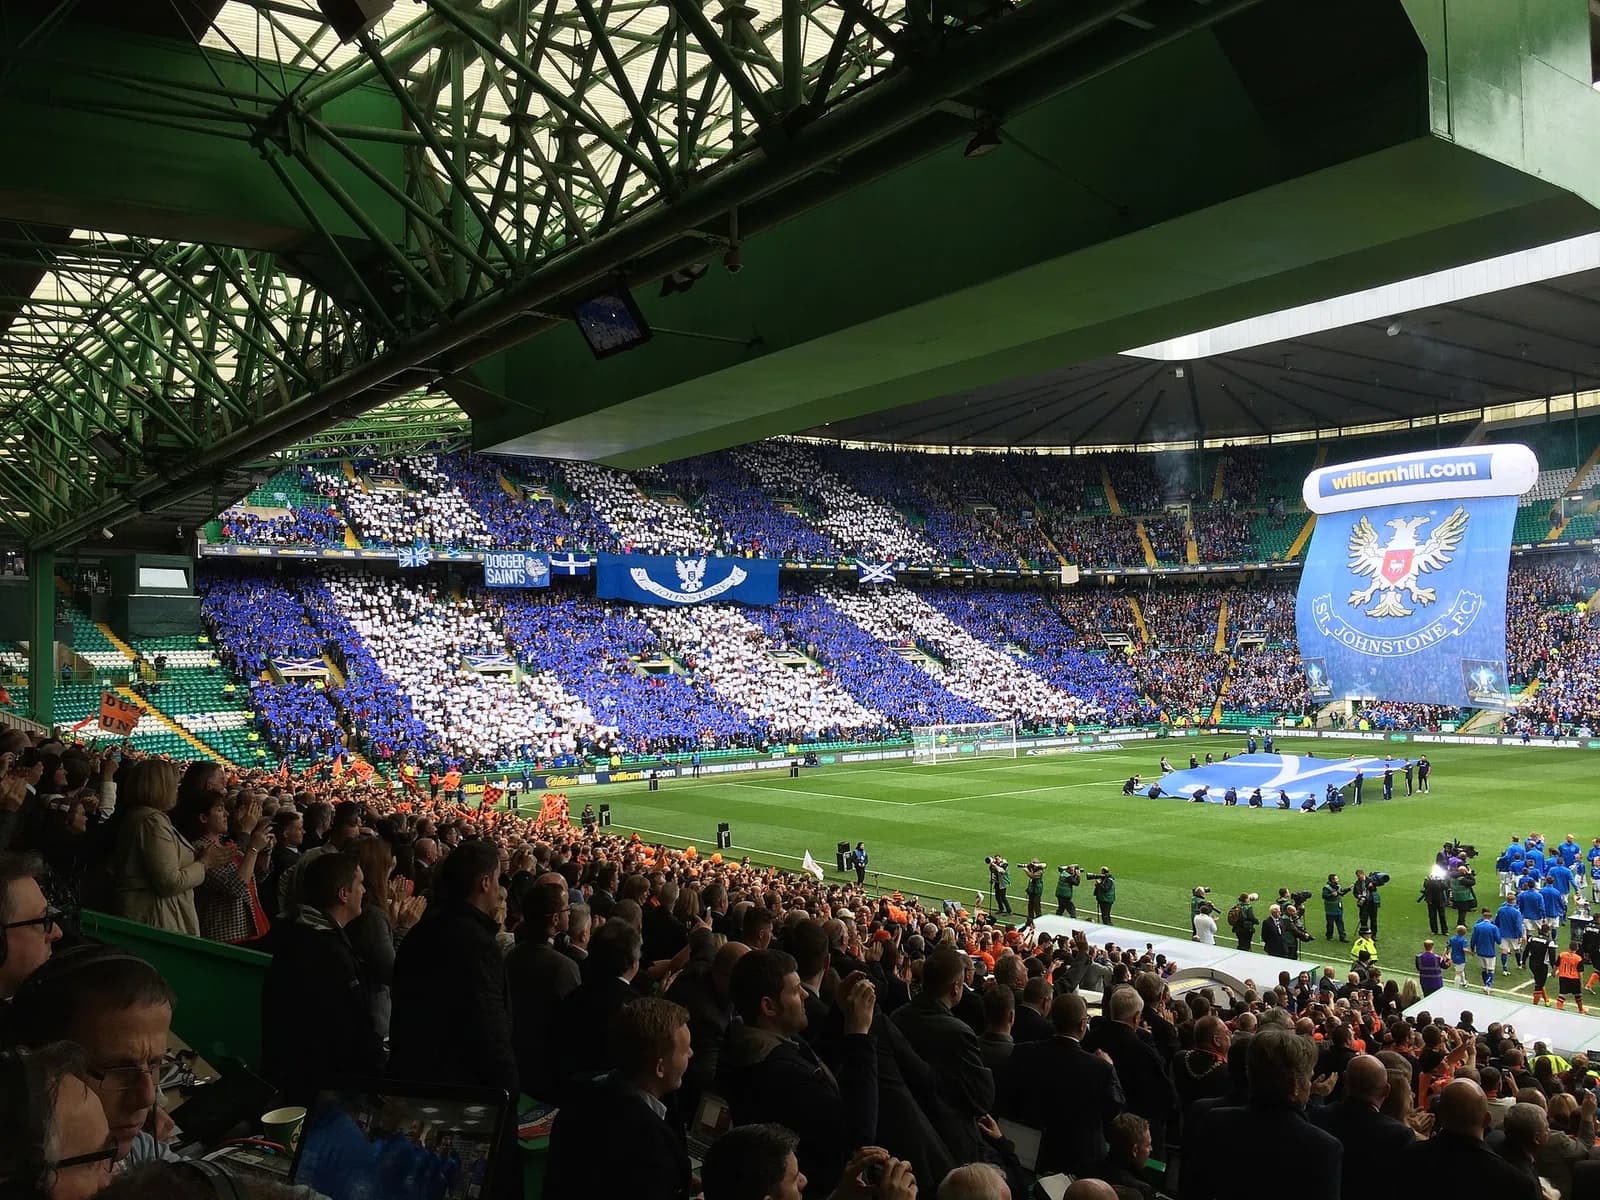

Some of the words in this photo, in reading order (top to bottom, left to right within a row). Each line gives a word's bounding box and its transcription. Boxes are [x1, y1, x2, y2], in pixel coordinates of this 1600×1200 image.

[1331, 461, 1477, 491] williamhill.com
[486, 553, 525, 569] DOGGER
[487, 568, 526, 584] SAINTS
[652, 582, 727, 601] JOHNSTONE
[1316, 602, 1331, 628] ST.
[1334, 623, 1447, 653] JOHNSTONE
[578, 773, 597, 784] HILL
